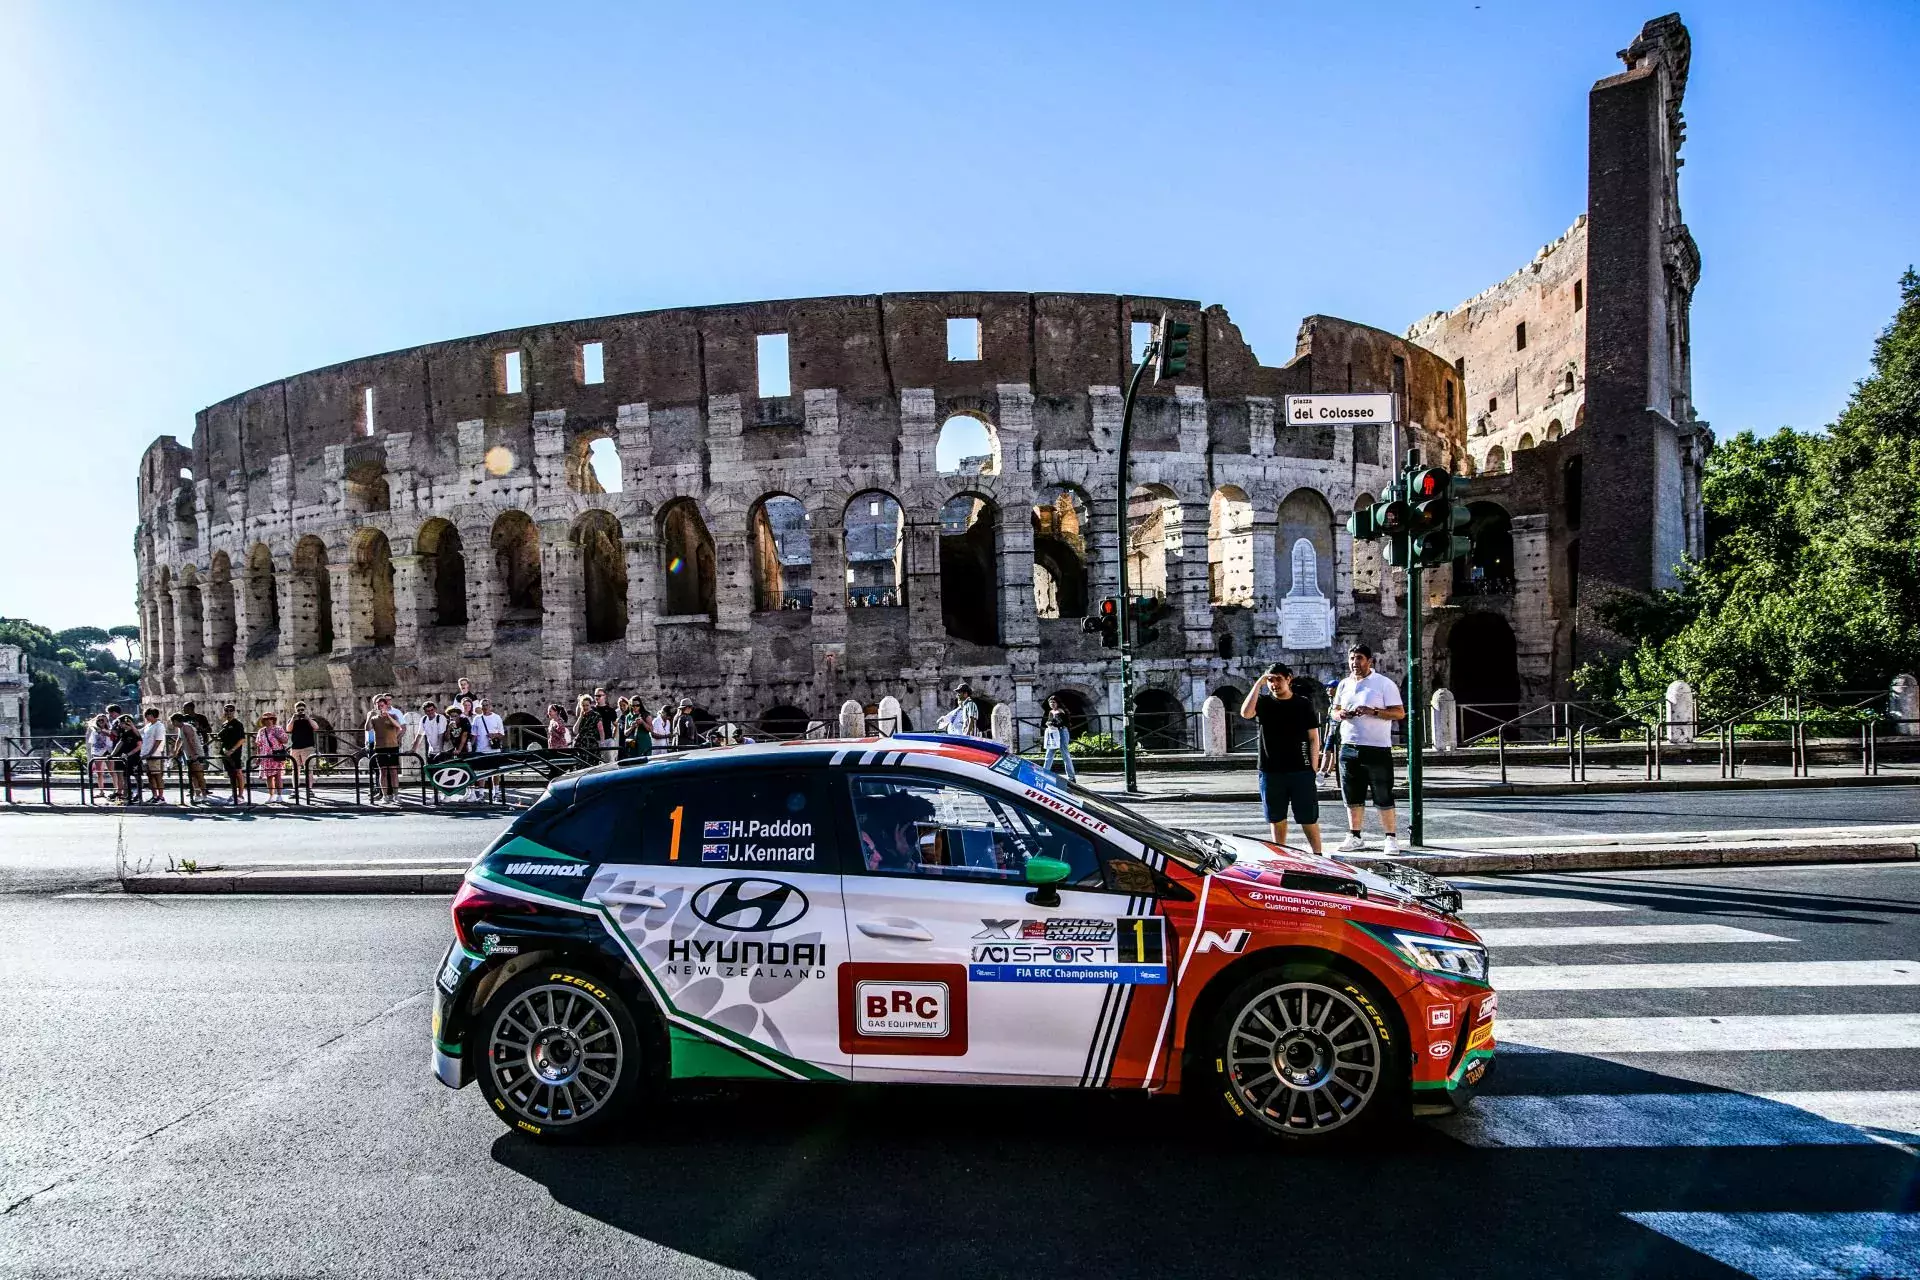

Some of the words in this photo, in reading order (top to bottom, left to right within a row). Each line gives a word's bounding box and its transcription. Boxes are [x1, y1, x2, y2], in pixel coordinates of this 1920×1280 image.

[1294, 408, 1313, 419] del
[1320, 407, 1374, 419] Colosseo
[1024, 789, 1109, 834] www.brc.it
[670, 805, 684, 860] 1
[731, 820, 812, 838] H.Paddon
[729, 842, 815, 861] J.Kennard
[1264, 894, 1302, 904] HYUNDAI
[1302, 898, 1353, 912] MOTORSPORT
[1265, 903, 1300, 912] Customer
[1301, 906, 1326, 917] Racing
[1046, 917, 1102, 927] RALLY
[1045, 926, 1116, 936] ROMA
[1133, 920, 1145, 963] 1
[668, 939, 826, 966] HYUNDAI
[1013, 946, 1115, 963] SPORT
[667, 966, 711, 976] NEW
[726, 967, 826, 979] ZEALAND
[1016, 968, 1031, 978] FIA
[1034, 969, 1052, 978] ERC
[1055, 969, 1119, 980] Championship
[867, 990, 939, 1019] BRC
[868, 1020, 886, 1028] GAS
[888, 1021, 938, 1029] EQUIPMENT
[1434, 1012, 1449, 1020] BRC
